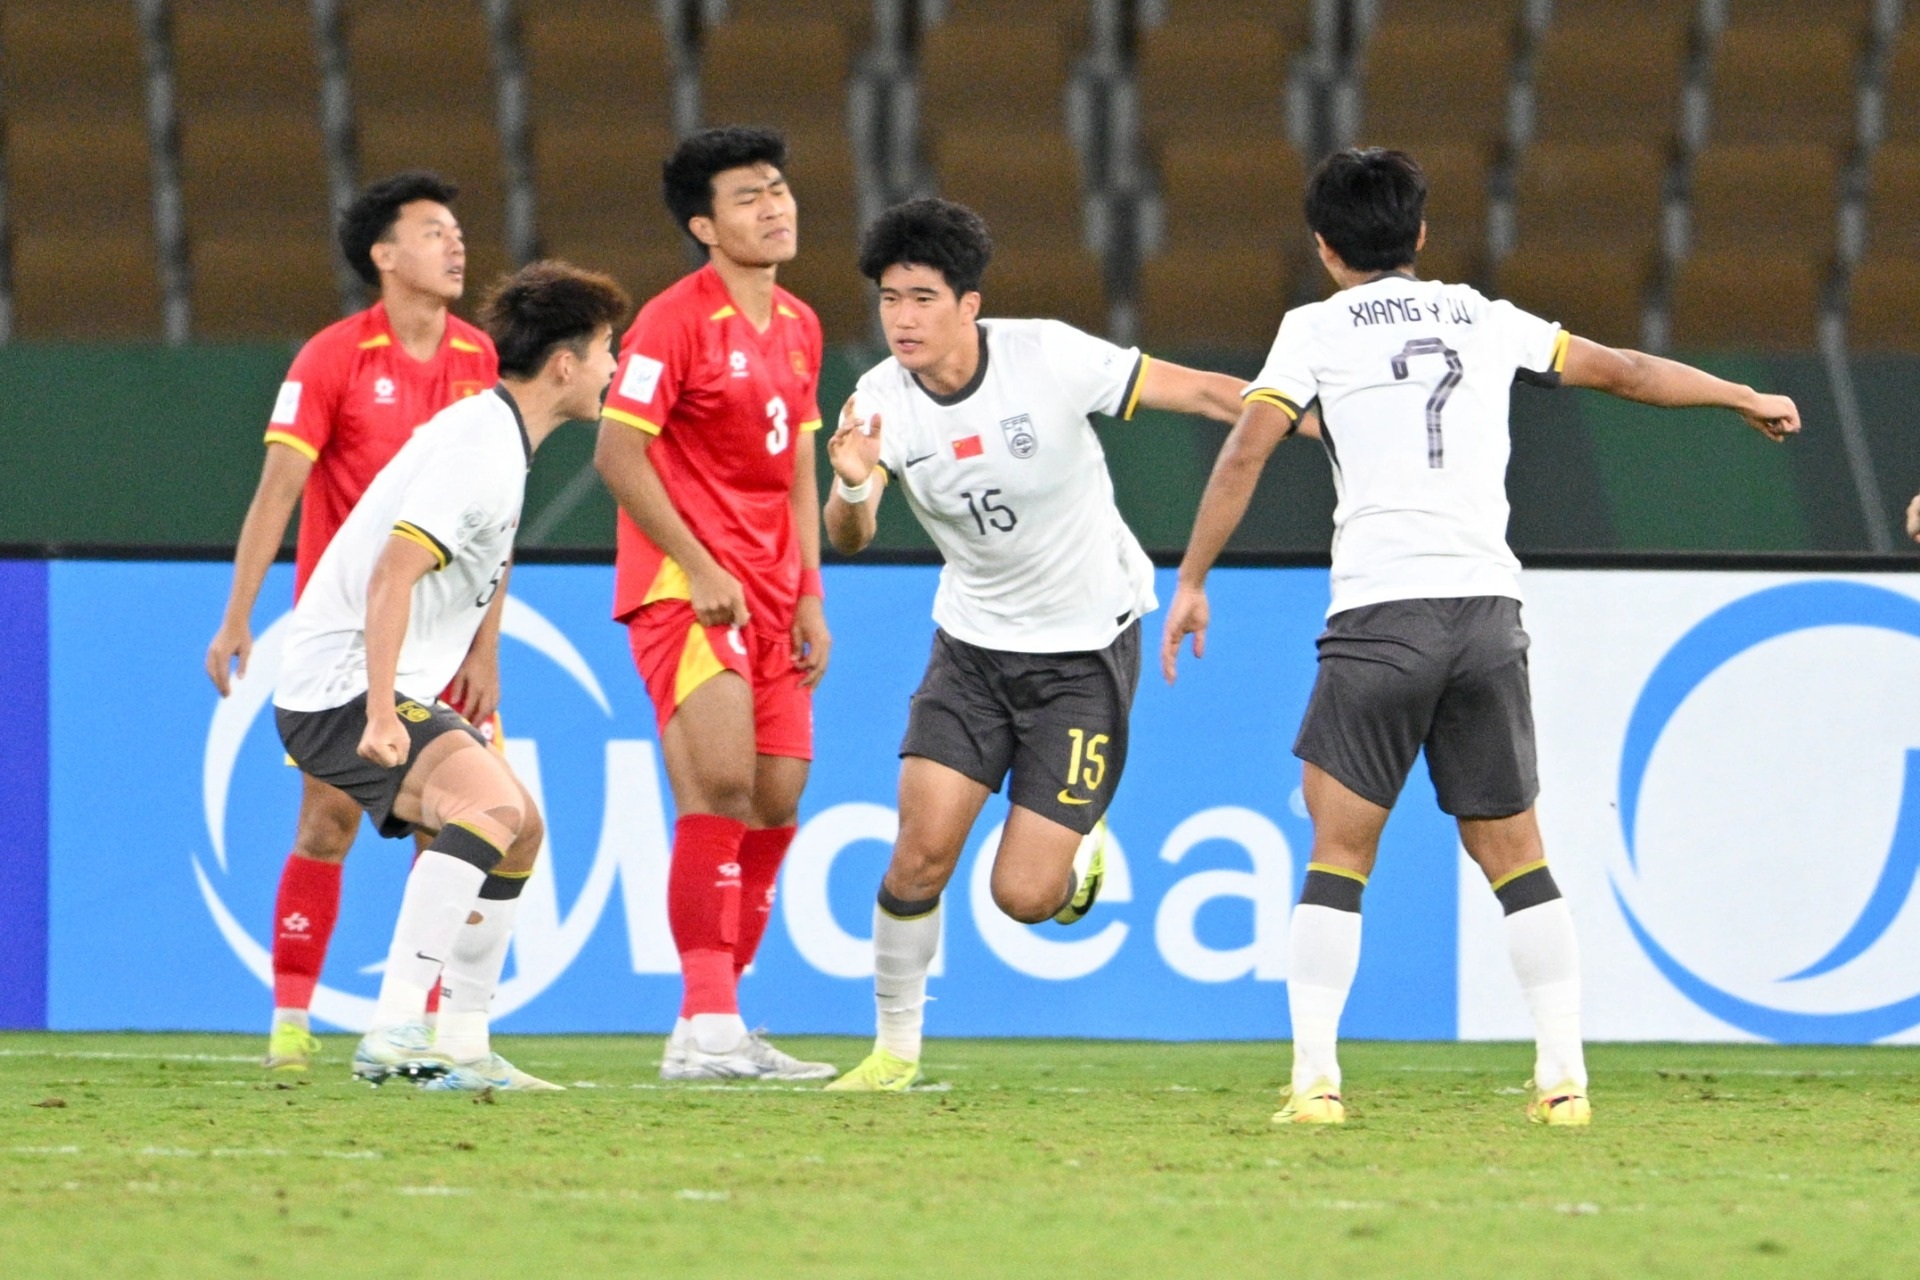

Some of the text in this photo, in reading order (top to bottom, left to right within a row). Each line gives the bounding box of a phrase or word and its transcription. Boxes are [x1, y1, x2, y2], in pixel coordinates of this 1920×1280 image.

[1348, 297, 1422, 327] XIANG
[765, 396, 789, 455] 3
[1391, 337, 1463, 469] 7
[960, 488, 1017, 535] 15
[1067, 728, 1109, 790] 15
[500, 738, 1294, 985] Mdea
